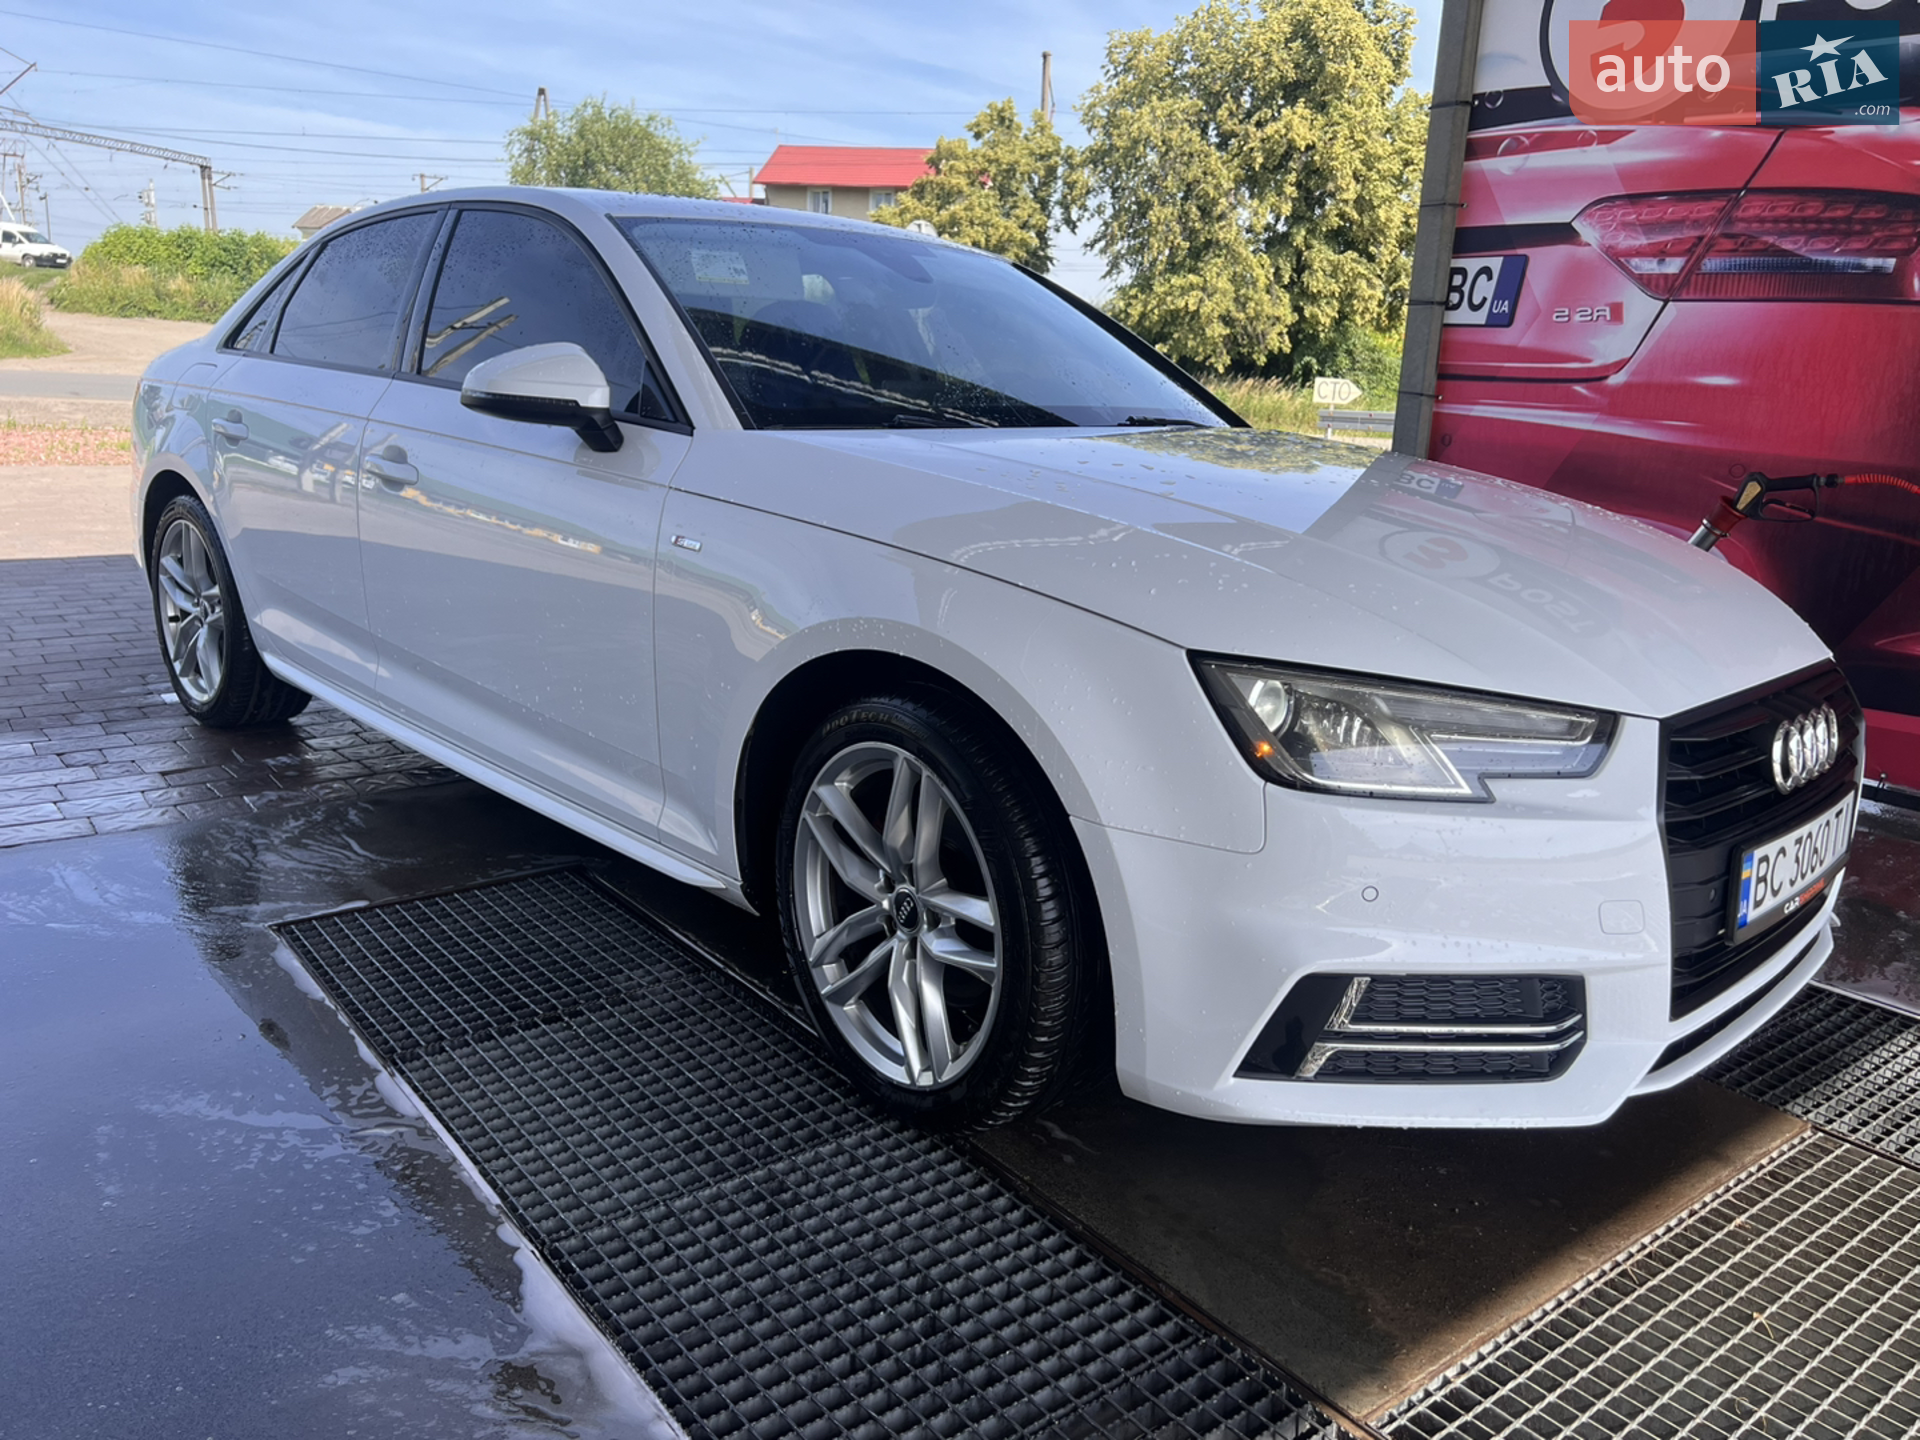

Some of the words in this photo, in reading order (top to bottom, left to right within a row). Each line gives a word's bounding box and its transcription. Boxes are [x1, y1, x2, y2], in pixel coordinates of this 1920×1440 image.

[1445, 265, 1493, 312] BC
[1492, 300, 1509, 314] UA
[1317, 380, 1351, 401] СТО
[1753, 846, 1786, 910] BC
[1789, 819, 1831, 888] 3060
